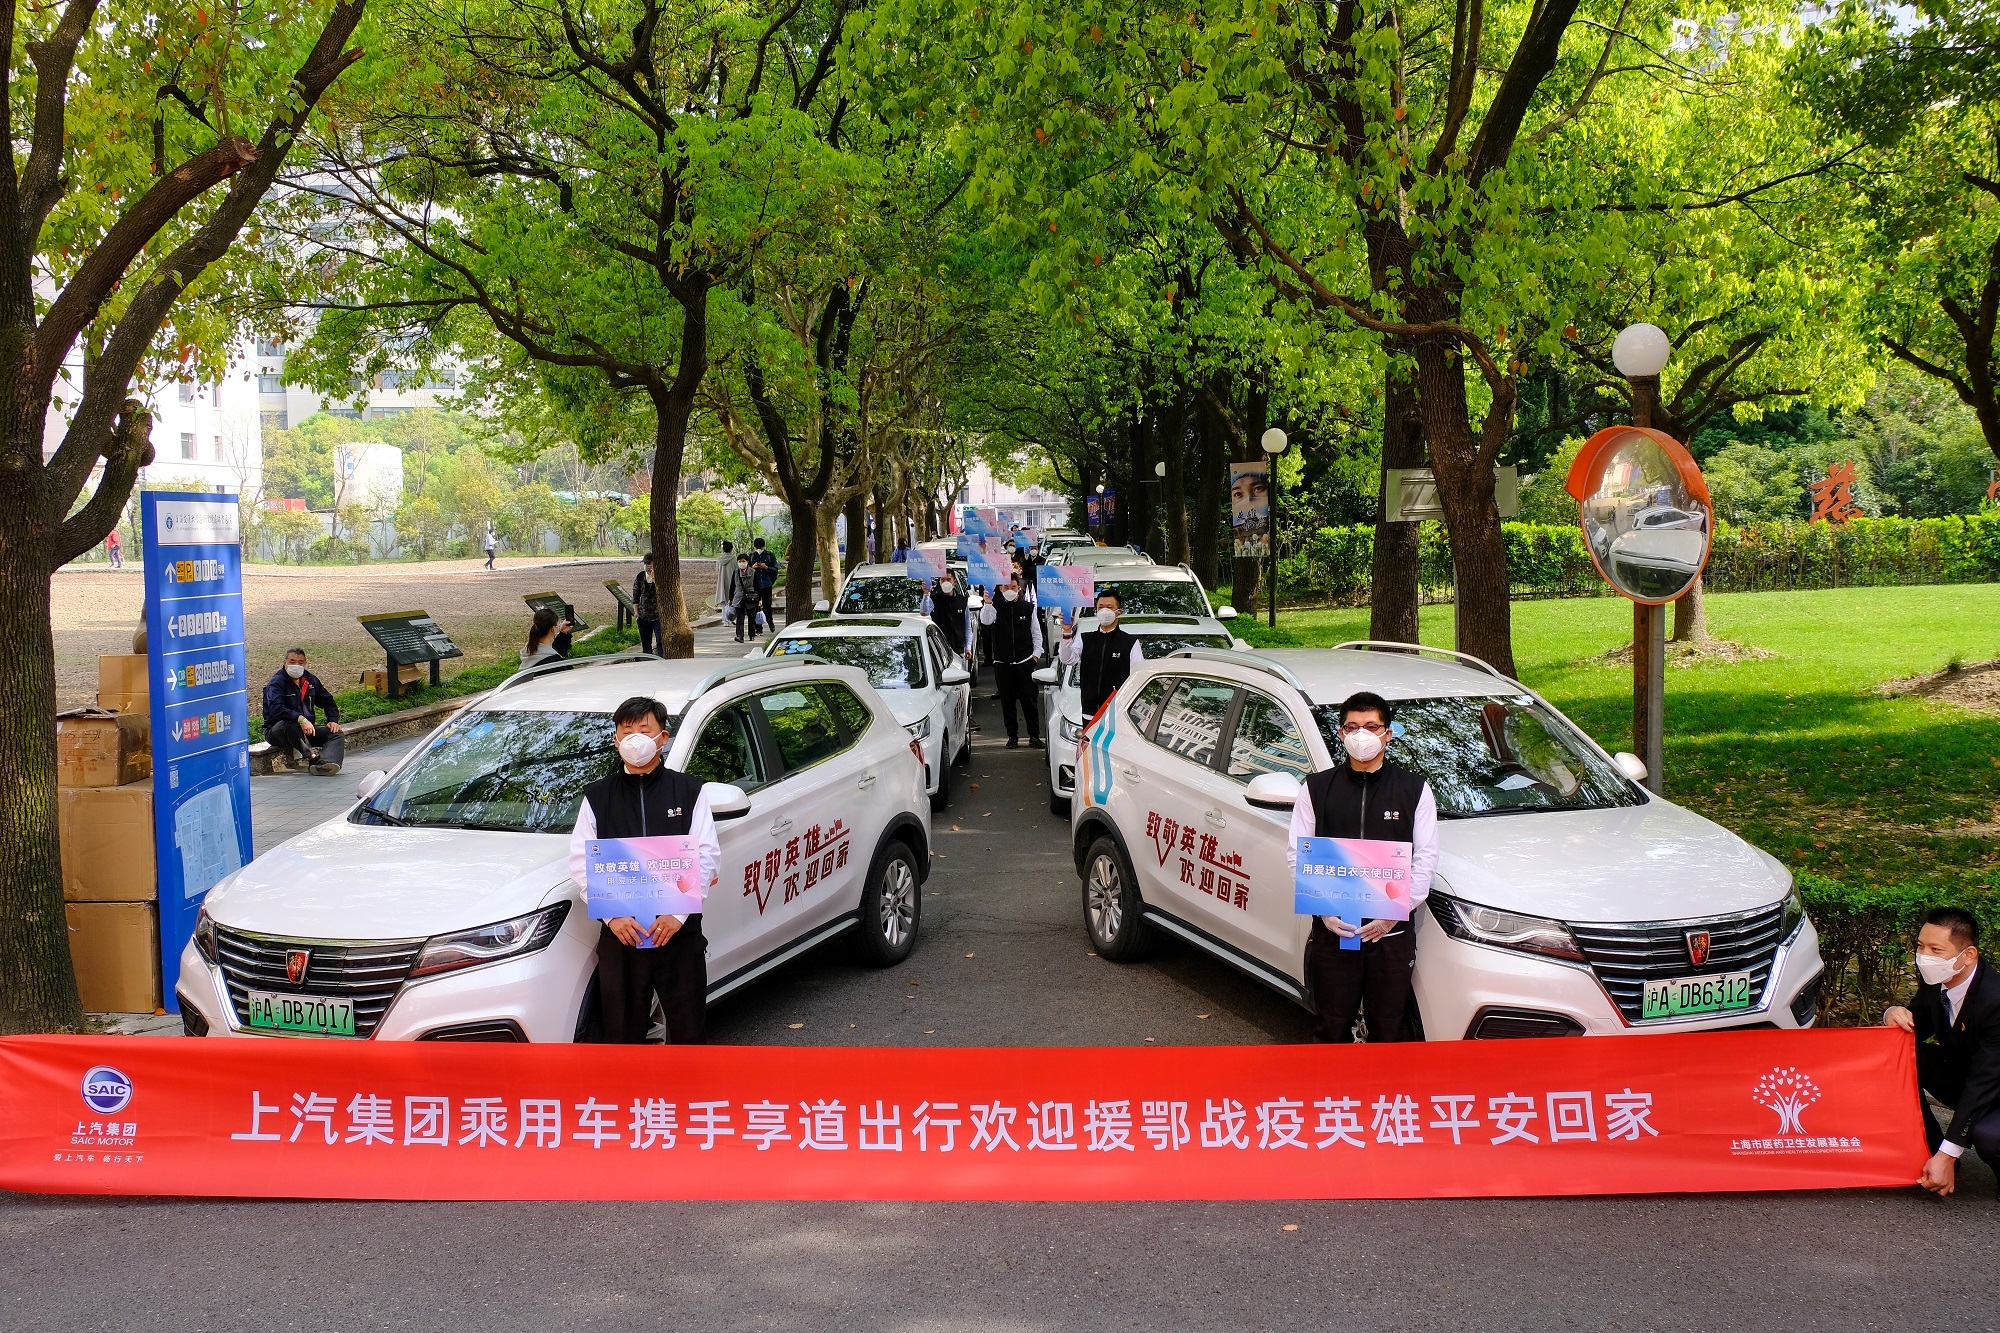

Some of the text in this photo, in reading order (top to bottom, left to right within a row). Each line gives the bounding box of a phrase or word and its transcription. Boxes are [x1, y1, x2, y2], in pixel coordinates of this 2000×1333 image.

[1146, 811, 1219, 868] 致敬英雄
[594, 858, 693, 873] 致敬英雄 欢迎回家
[743, 824, 821, 916] 致敬英雄
[783, 840, 850, 905] 欢迎回家
[1302, 864, 1405, 880] 用爱送白衣天使回家
[1179, 857, 1250, 911] 欢迎回家
[87, 1084, 126, 1095] SAIC
[231, 1087, 1660, 1153] 上汽集团乘用车携手享道出行欢迎援鄂战疫英雄平安回家
[72, 1121, 137, 1137] 上汽集团
[71, 1136, 134, 1146] SAIC MOTOR
[1730, 1136, 1861, 1150] 上海市医药卫生发展基金会
[53, 1153, 143, 1163] 爱上汽车 畅行天下
